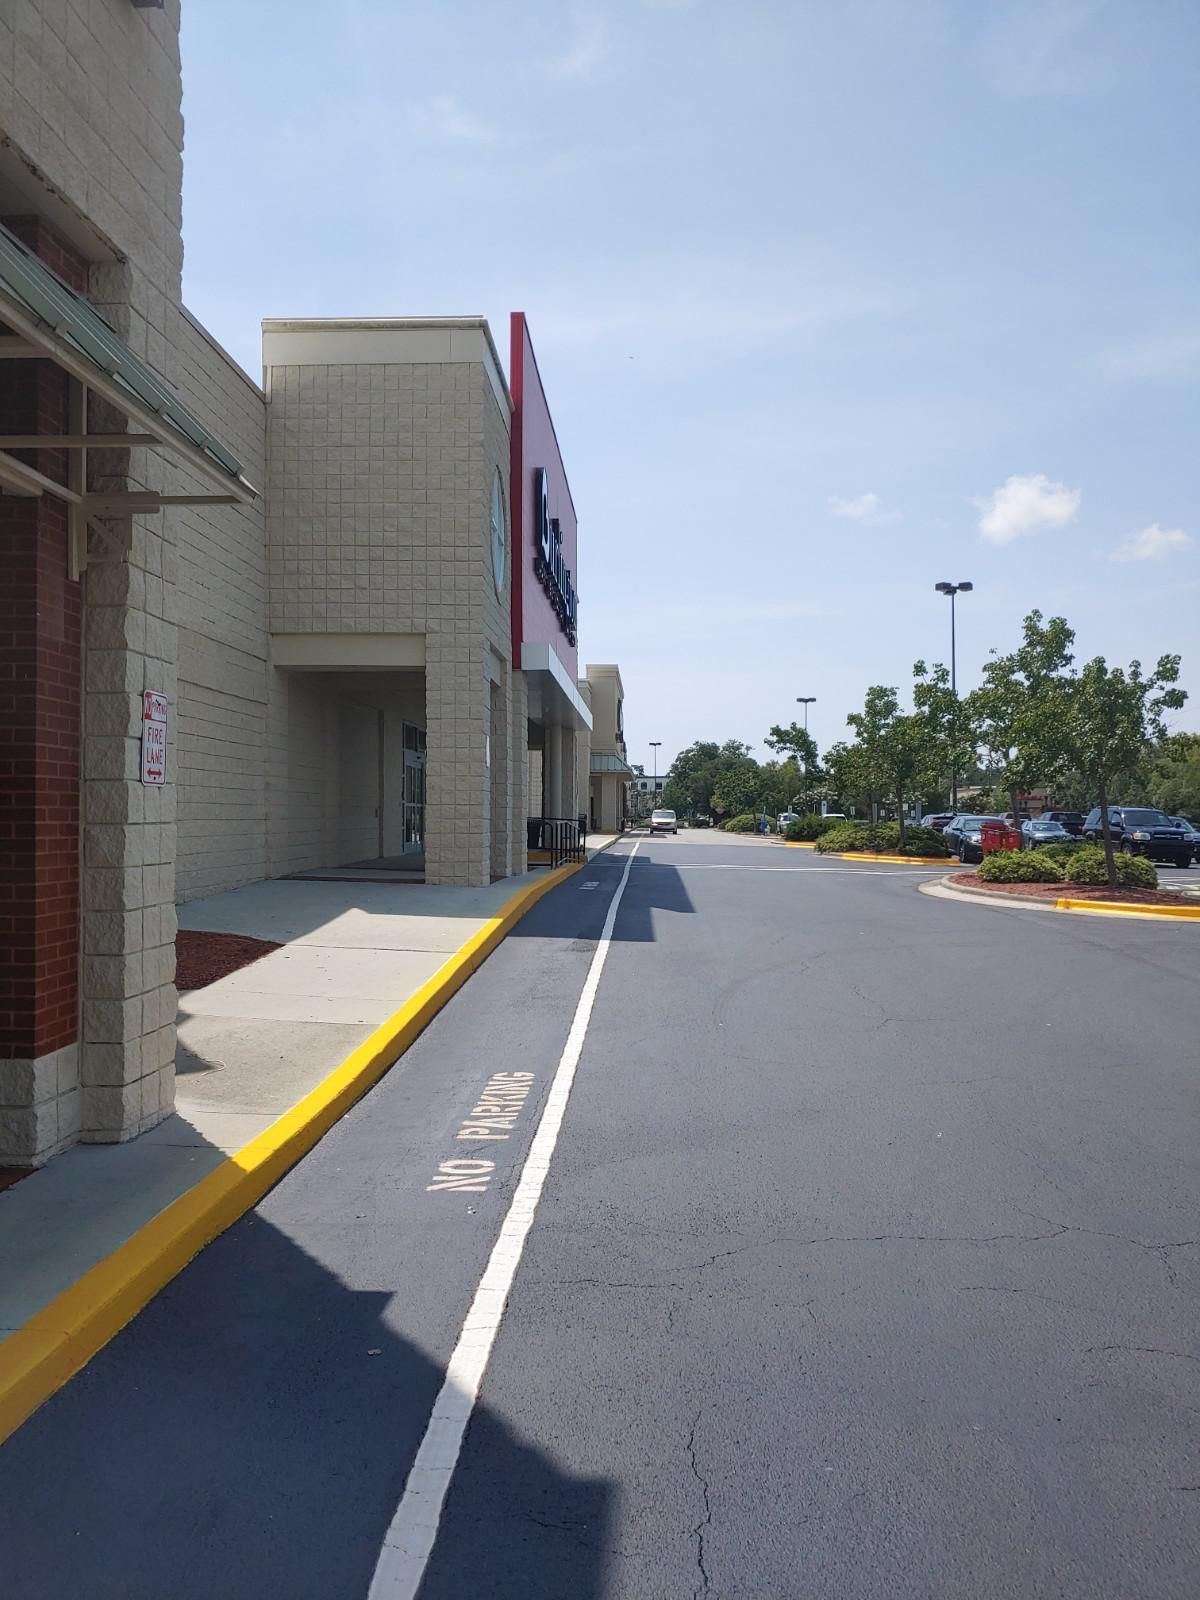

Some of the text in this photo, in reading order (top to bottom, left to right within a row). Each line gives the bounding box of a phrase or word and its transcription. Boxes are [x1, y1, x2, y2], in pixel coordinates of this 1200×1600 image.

[147, 727, 163, 745] FIRE
[146, 747, 163, 765] LANE
[425, 1071, 536, 1192] NO PARKING
